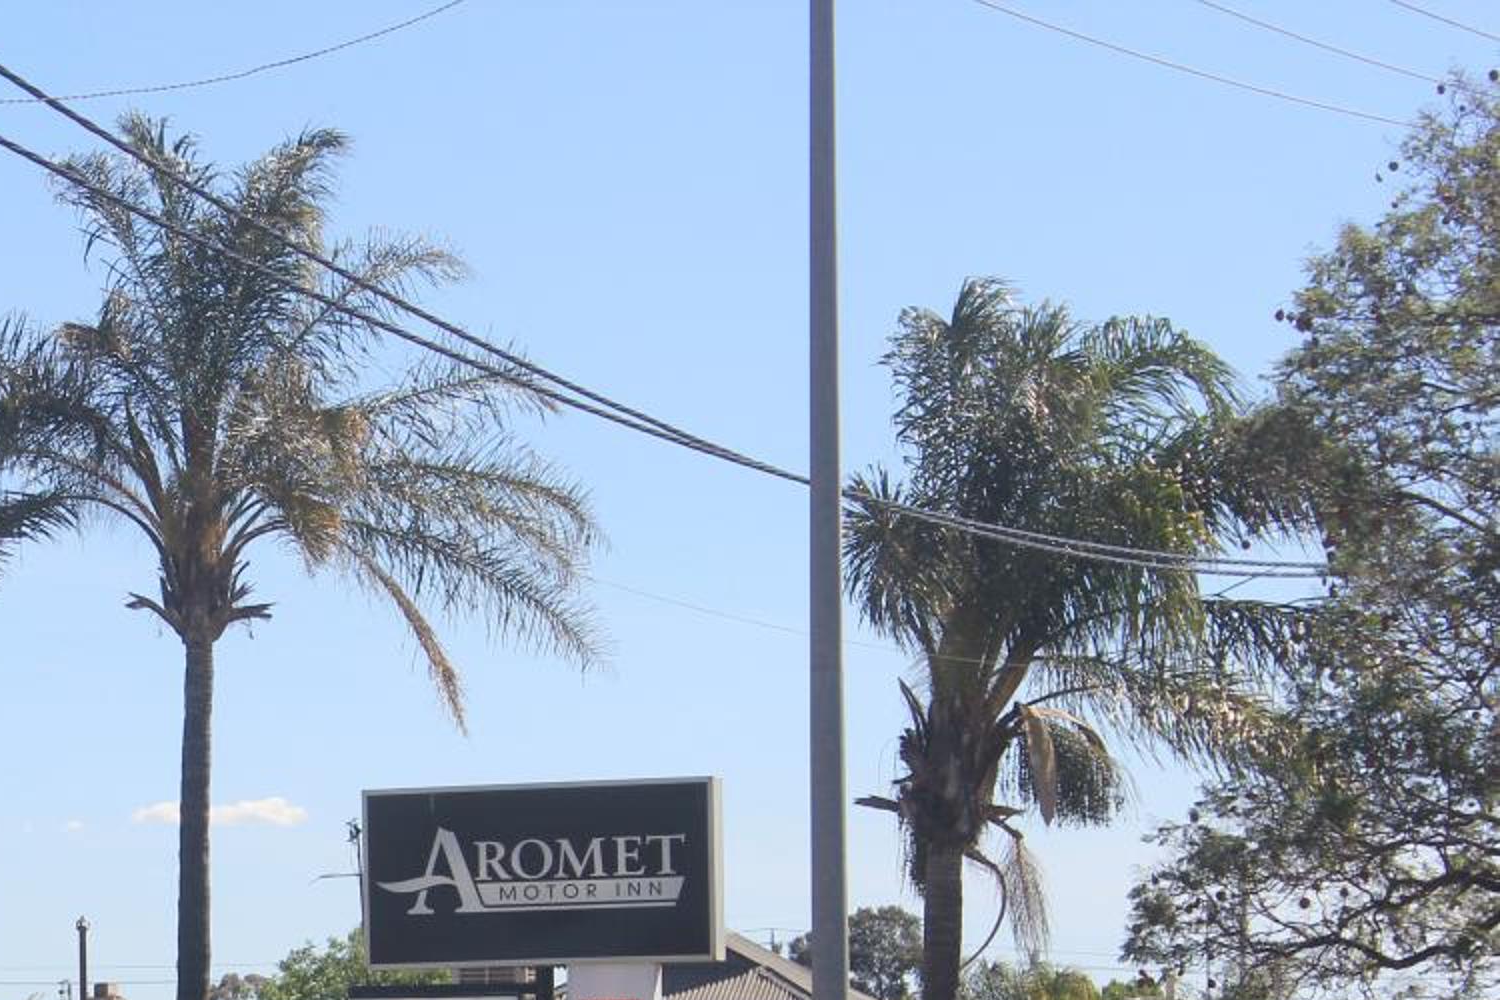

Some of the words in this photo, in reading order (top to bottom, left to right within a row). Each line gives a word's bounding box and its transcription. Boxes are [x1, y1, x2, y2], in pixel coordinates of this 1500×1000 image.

[376, 826, 686, 915] AROMET
[499, 882, 598, 902] MOTOR
[614, 880, 663, 897] INN
